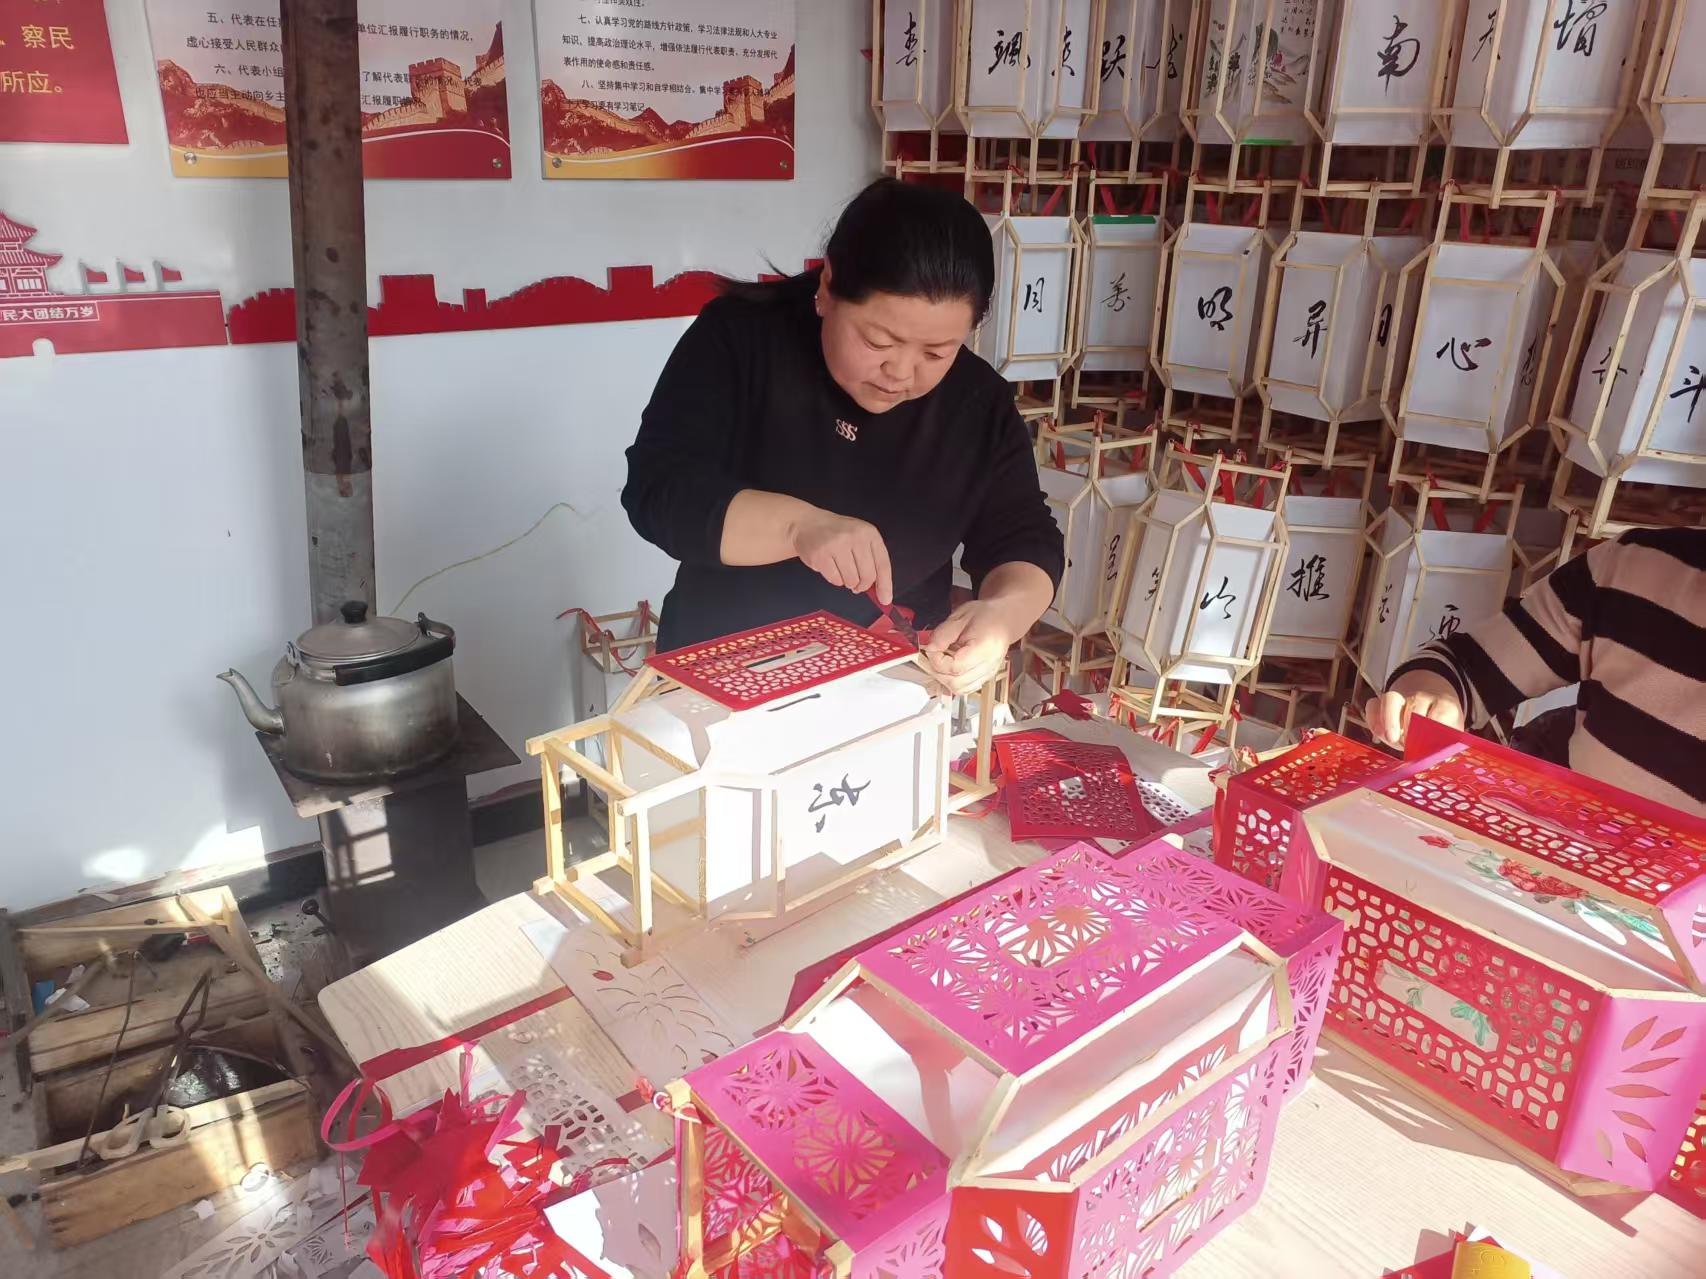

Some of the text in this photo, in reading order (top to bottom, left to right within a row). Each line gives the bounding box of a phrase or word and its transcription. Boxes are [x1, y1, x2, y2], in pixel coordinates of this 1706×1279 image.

[207, 12, 281, 29] 五、代表在任
[186, 35, 283, 53] 虚心接受人民群众
[1377, 14, 1421, 96] 南
[0, 306, 94, 321] 民大团结万岁
[1436, 336, 1492, 372] 心
